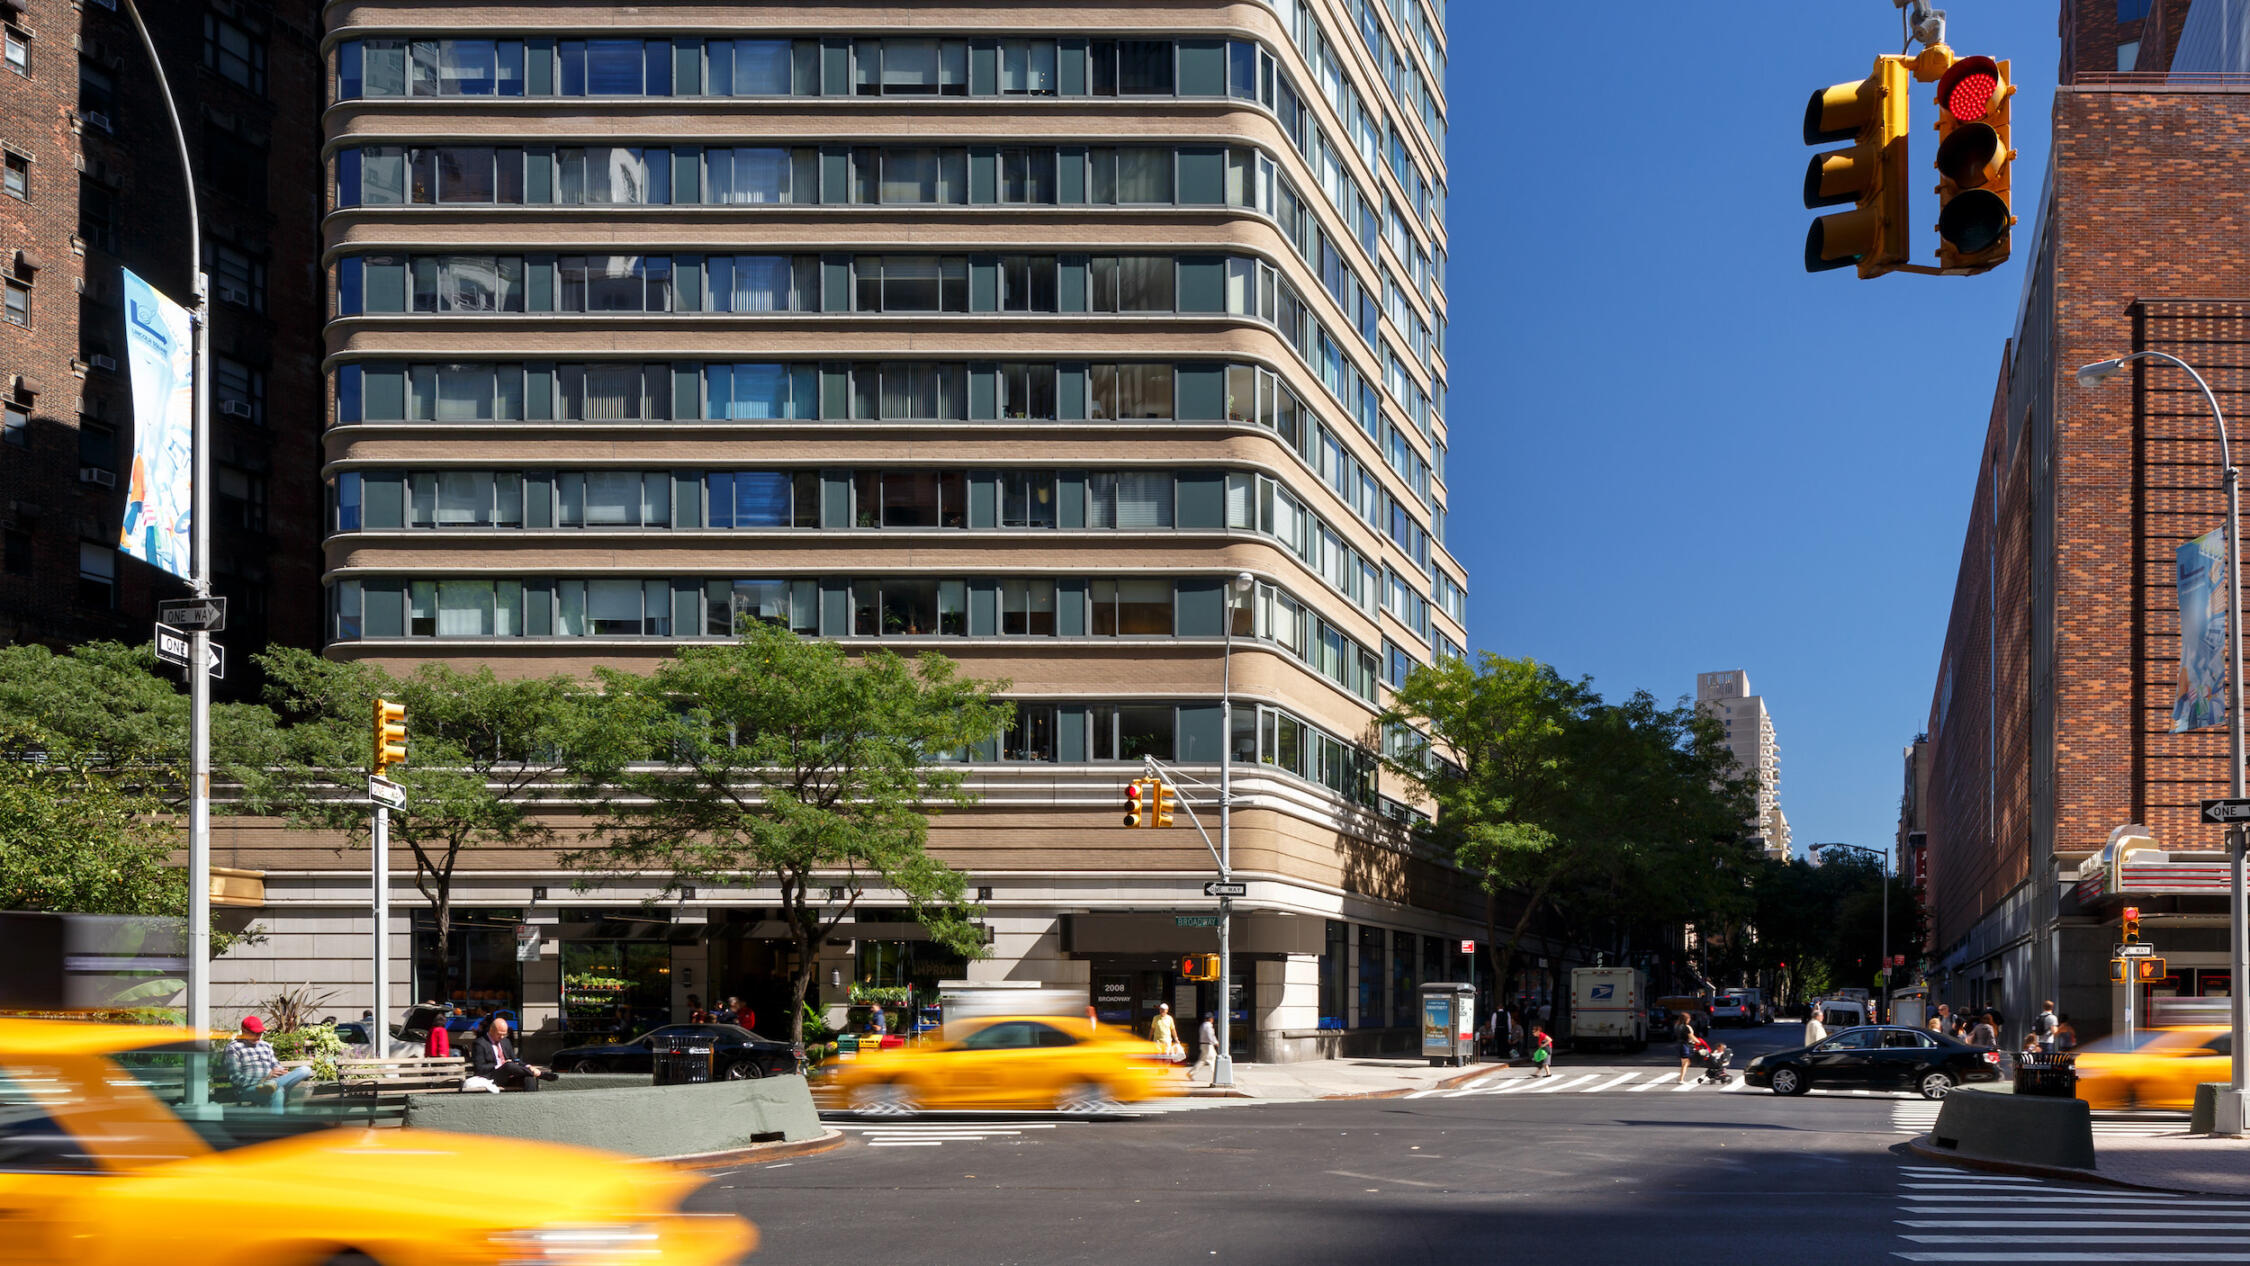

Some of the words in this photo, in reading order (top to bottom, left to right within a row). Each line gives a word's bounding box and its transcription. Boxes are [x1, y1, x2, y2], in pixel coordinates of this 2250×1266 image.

[167, 610, 186, 623] ONE
[194, 608, 214, 621] WAY
[166, 638, 186, 655] ONE
[2214, 806, 2237, 817] ONE
[1177, 917, 1217, 926] BROADWAY
[1104, 984, 1125, 992] 2008
